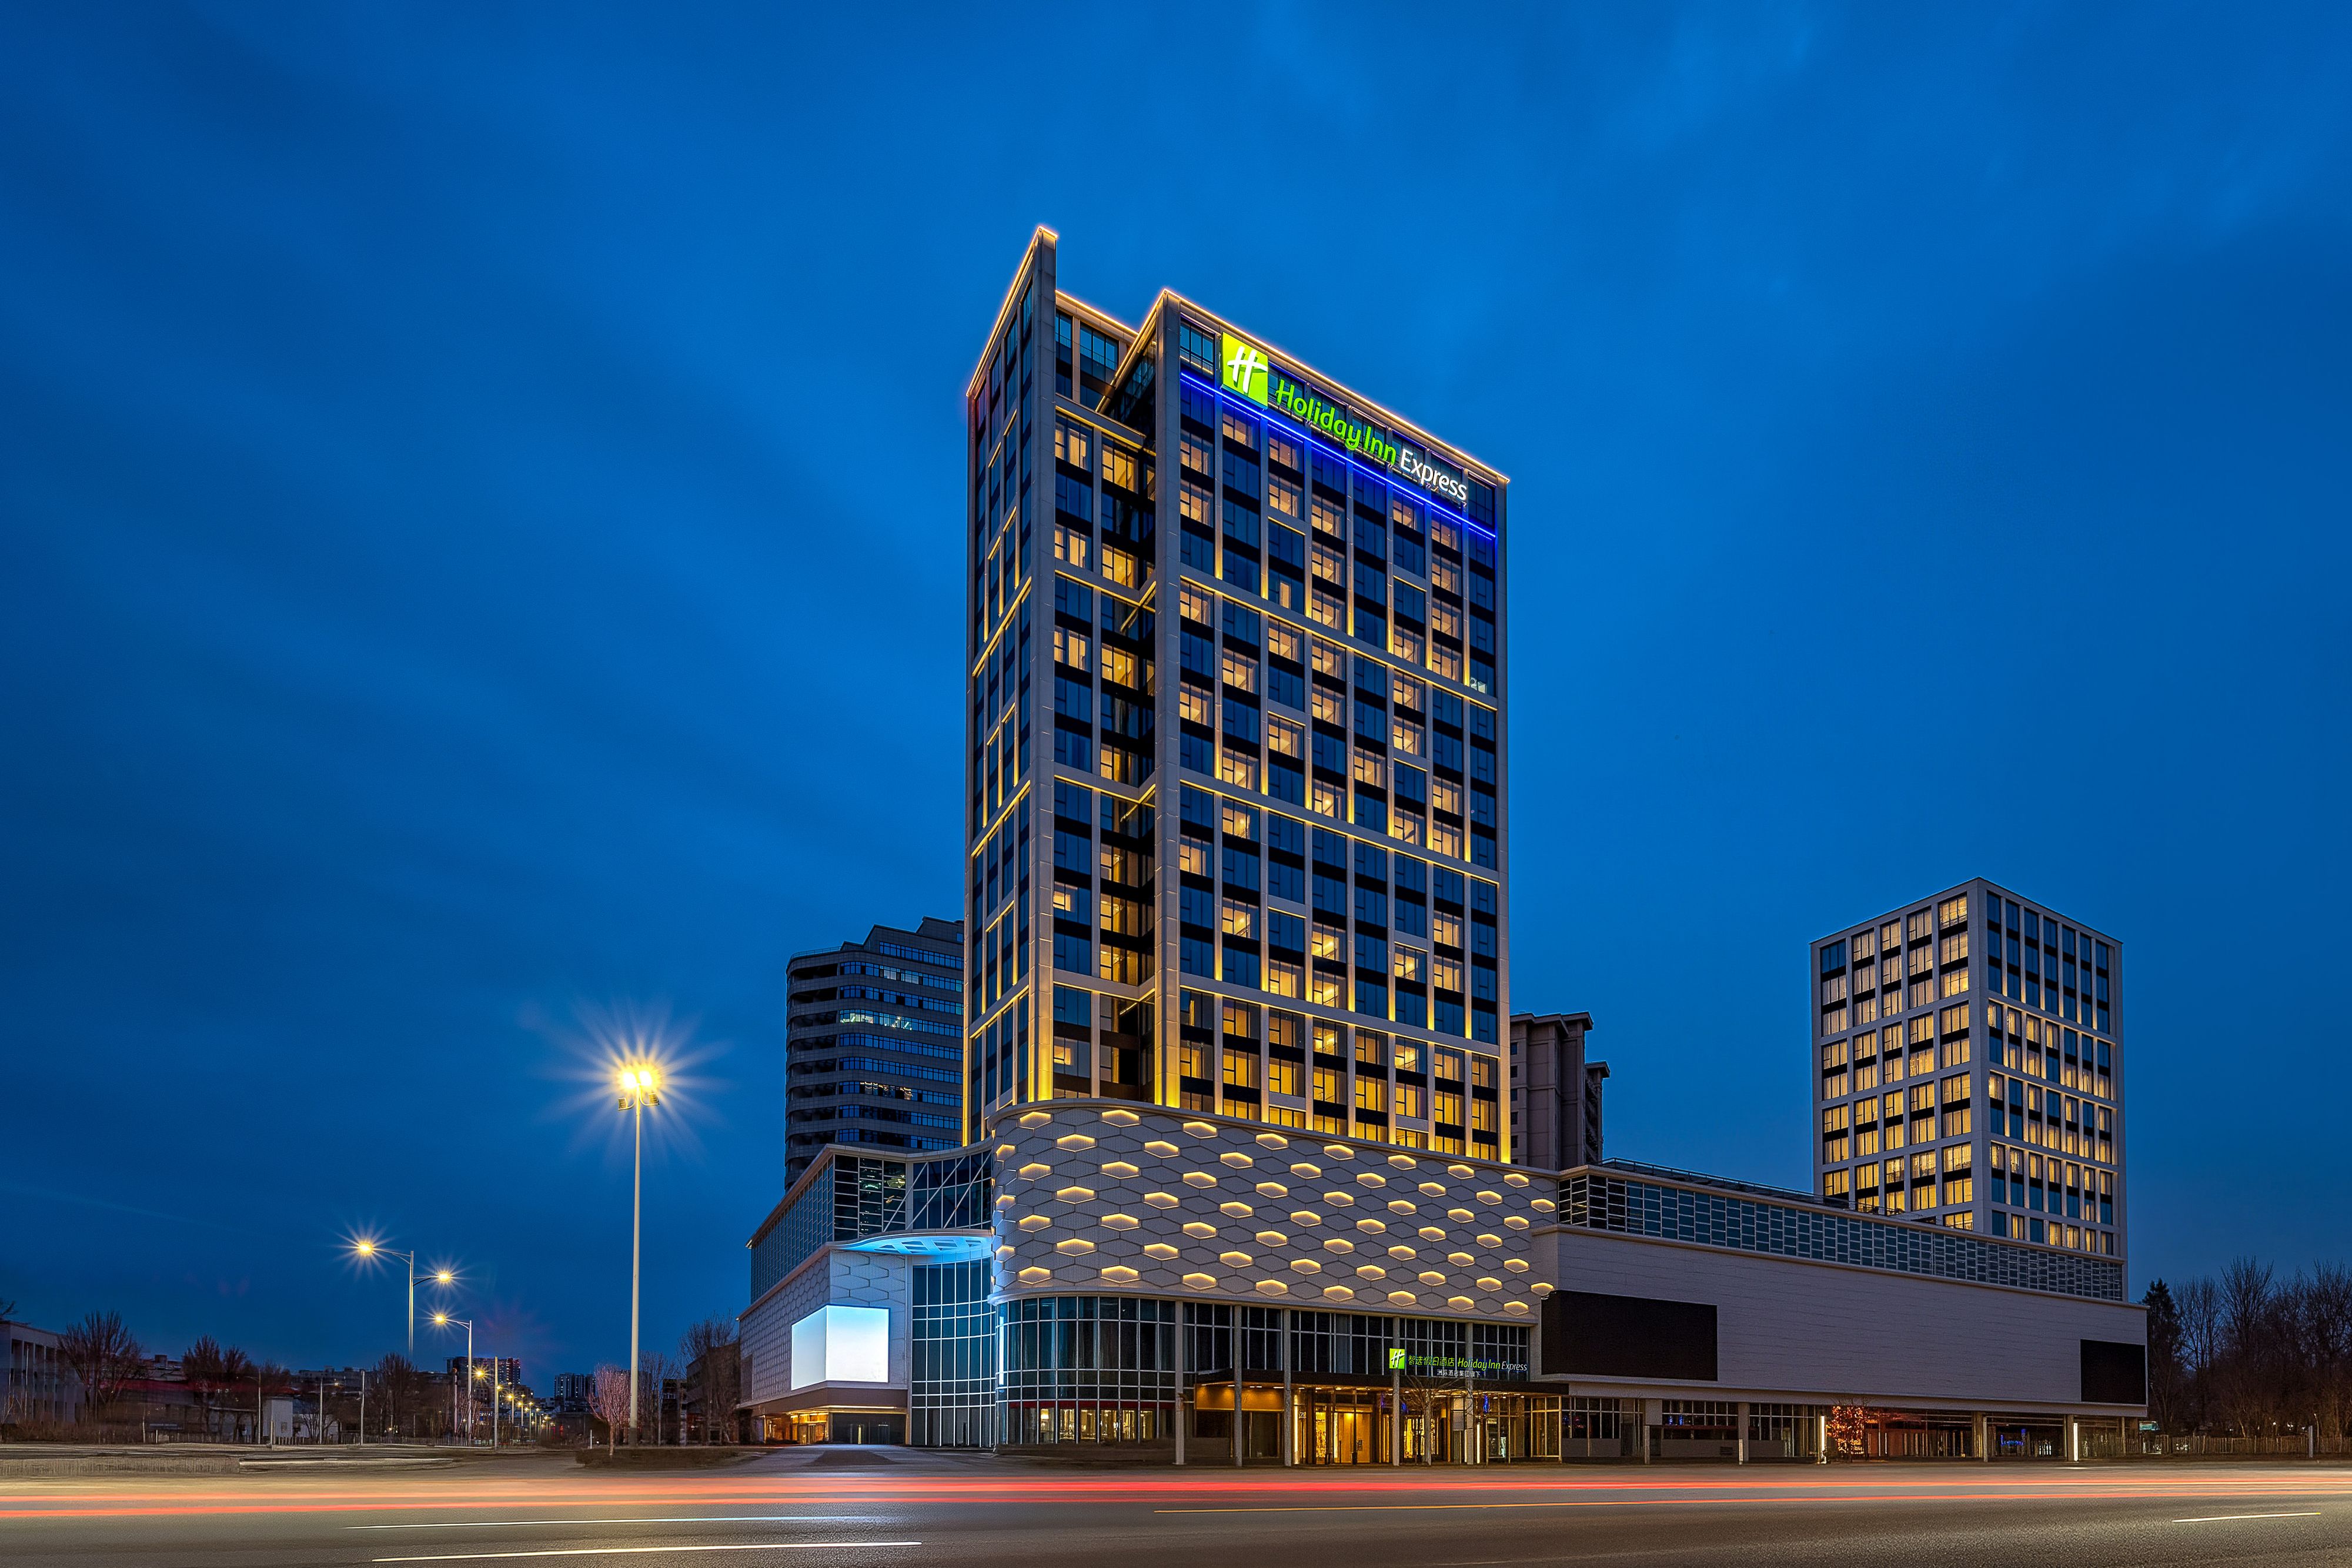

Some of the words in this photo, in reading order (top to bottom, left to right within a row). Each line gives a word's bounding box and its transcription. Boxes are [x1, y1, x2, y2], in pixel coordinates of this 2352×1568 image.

[1275, 378, 1362, 450] Holiday
[1363, 425, 1396, 466] Inn
[1399, 447, 1468, 501] Express
[1408, 1355, 1455, 1367] 智选假日酒店
[1458, 1358, 1487, 1371] Holiday
[1488, 1359, 1501, 1369] Inn
[1501, 1361, 1528, 1372] Express
[1437, 1369, 1481, 1378] 洲际酒店集团旗下
